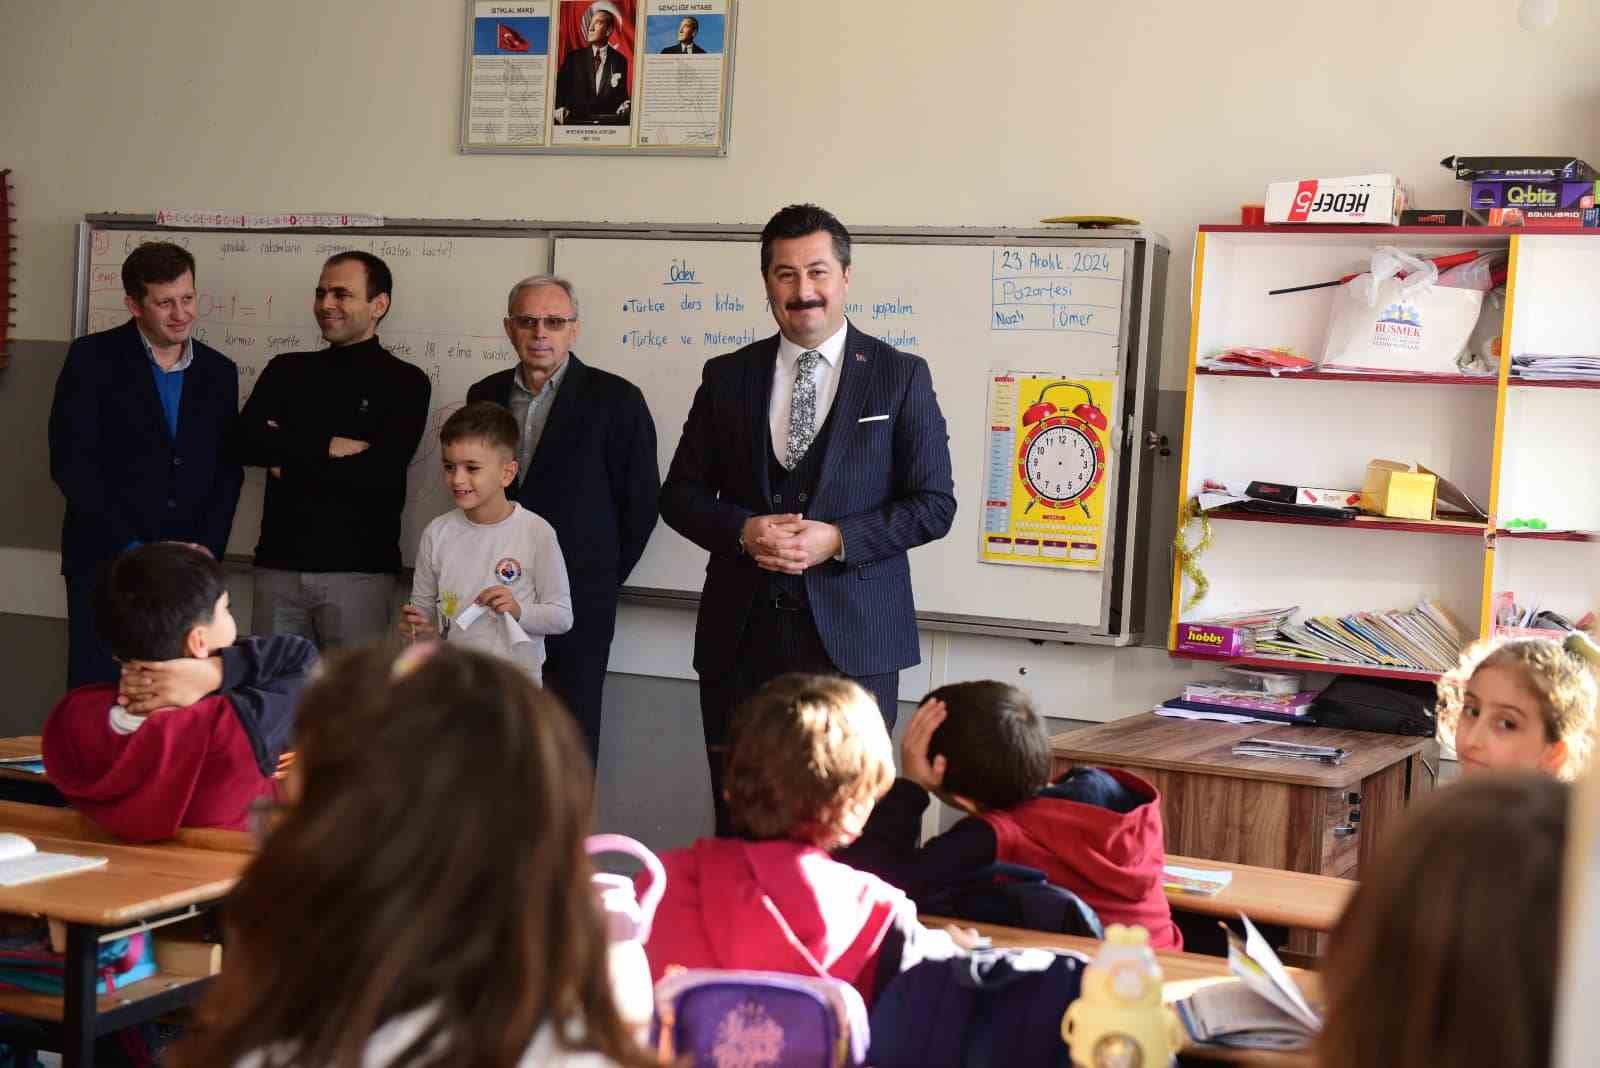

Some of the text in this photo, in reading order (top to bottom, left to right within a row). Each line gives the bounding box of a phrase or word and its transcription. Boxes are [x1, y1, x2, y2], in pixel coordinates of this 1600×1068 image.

[1312, 193, 1370, 213] HEDEF
[669, 257, 697, 281] Ödev
[1002, 250, 1022, 271] 23
[1072, 252, 1110, 272] 2024
[627, 297, 665, 314] Türkçe
[680, 292, 703, 311] ders
[628, 330, 669, 348] Türkçe
[680, 334, 694, 345] ve
[1188, 630, 1225, 645] hobby
